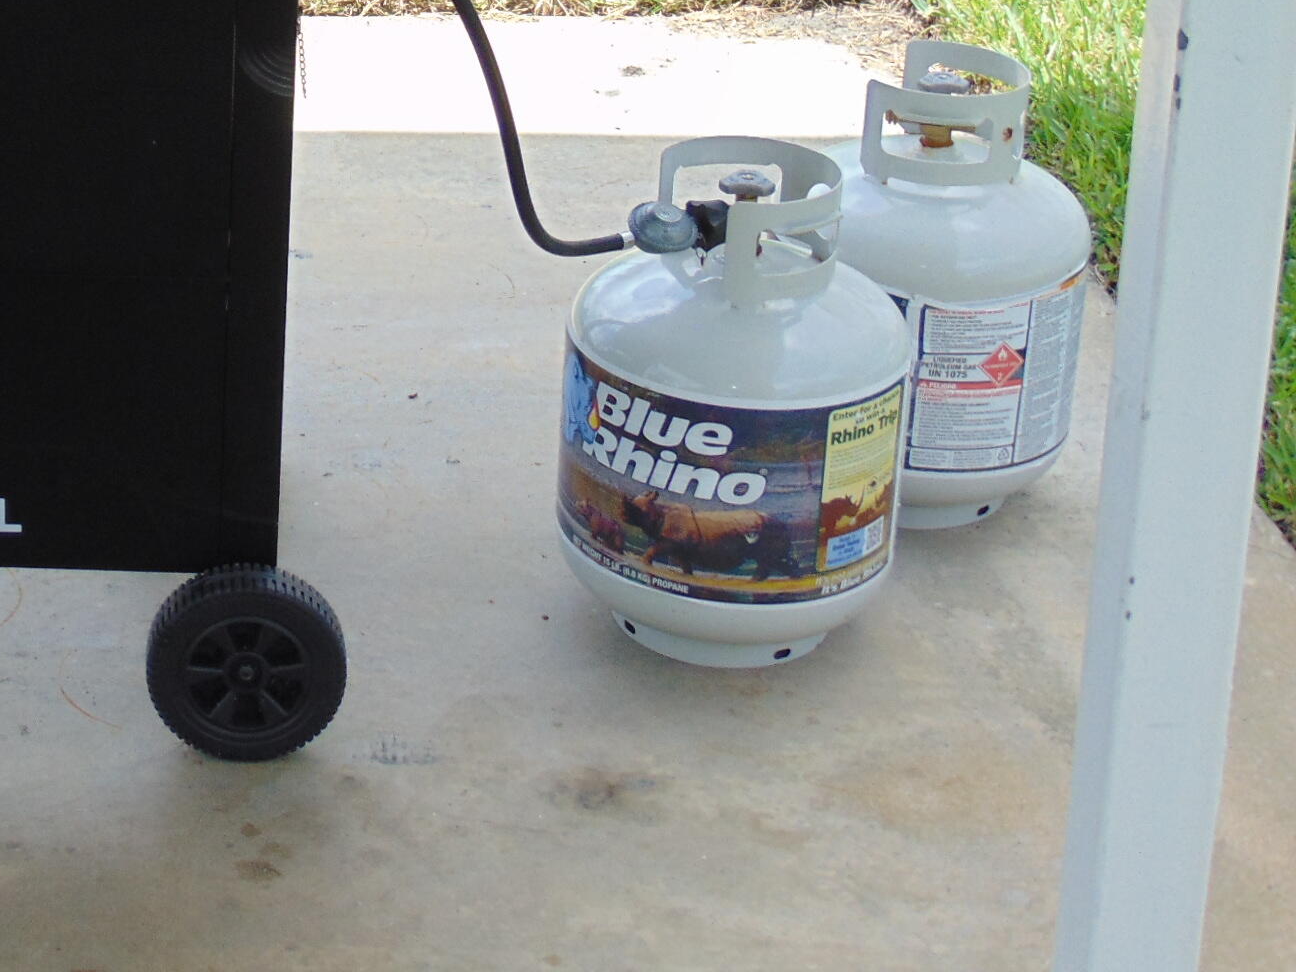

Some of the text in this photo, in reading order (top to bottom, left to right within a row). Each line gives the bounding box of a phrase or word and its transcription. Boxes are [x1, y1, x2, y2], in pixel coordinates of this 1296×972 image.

[928, 369, 968, 378] UN 1075
[595, 380, 734, 456] Blue
[830, 423, 874, 445] Rhino
[878, 408, 898, 429] Trip
[832, 410, 858, 422] Enter
[583, 425, 767, 505] Rhino
[652, 577, 690, 594] PROPANE
